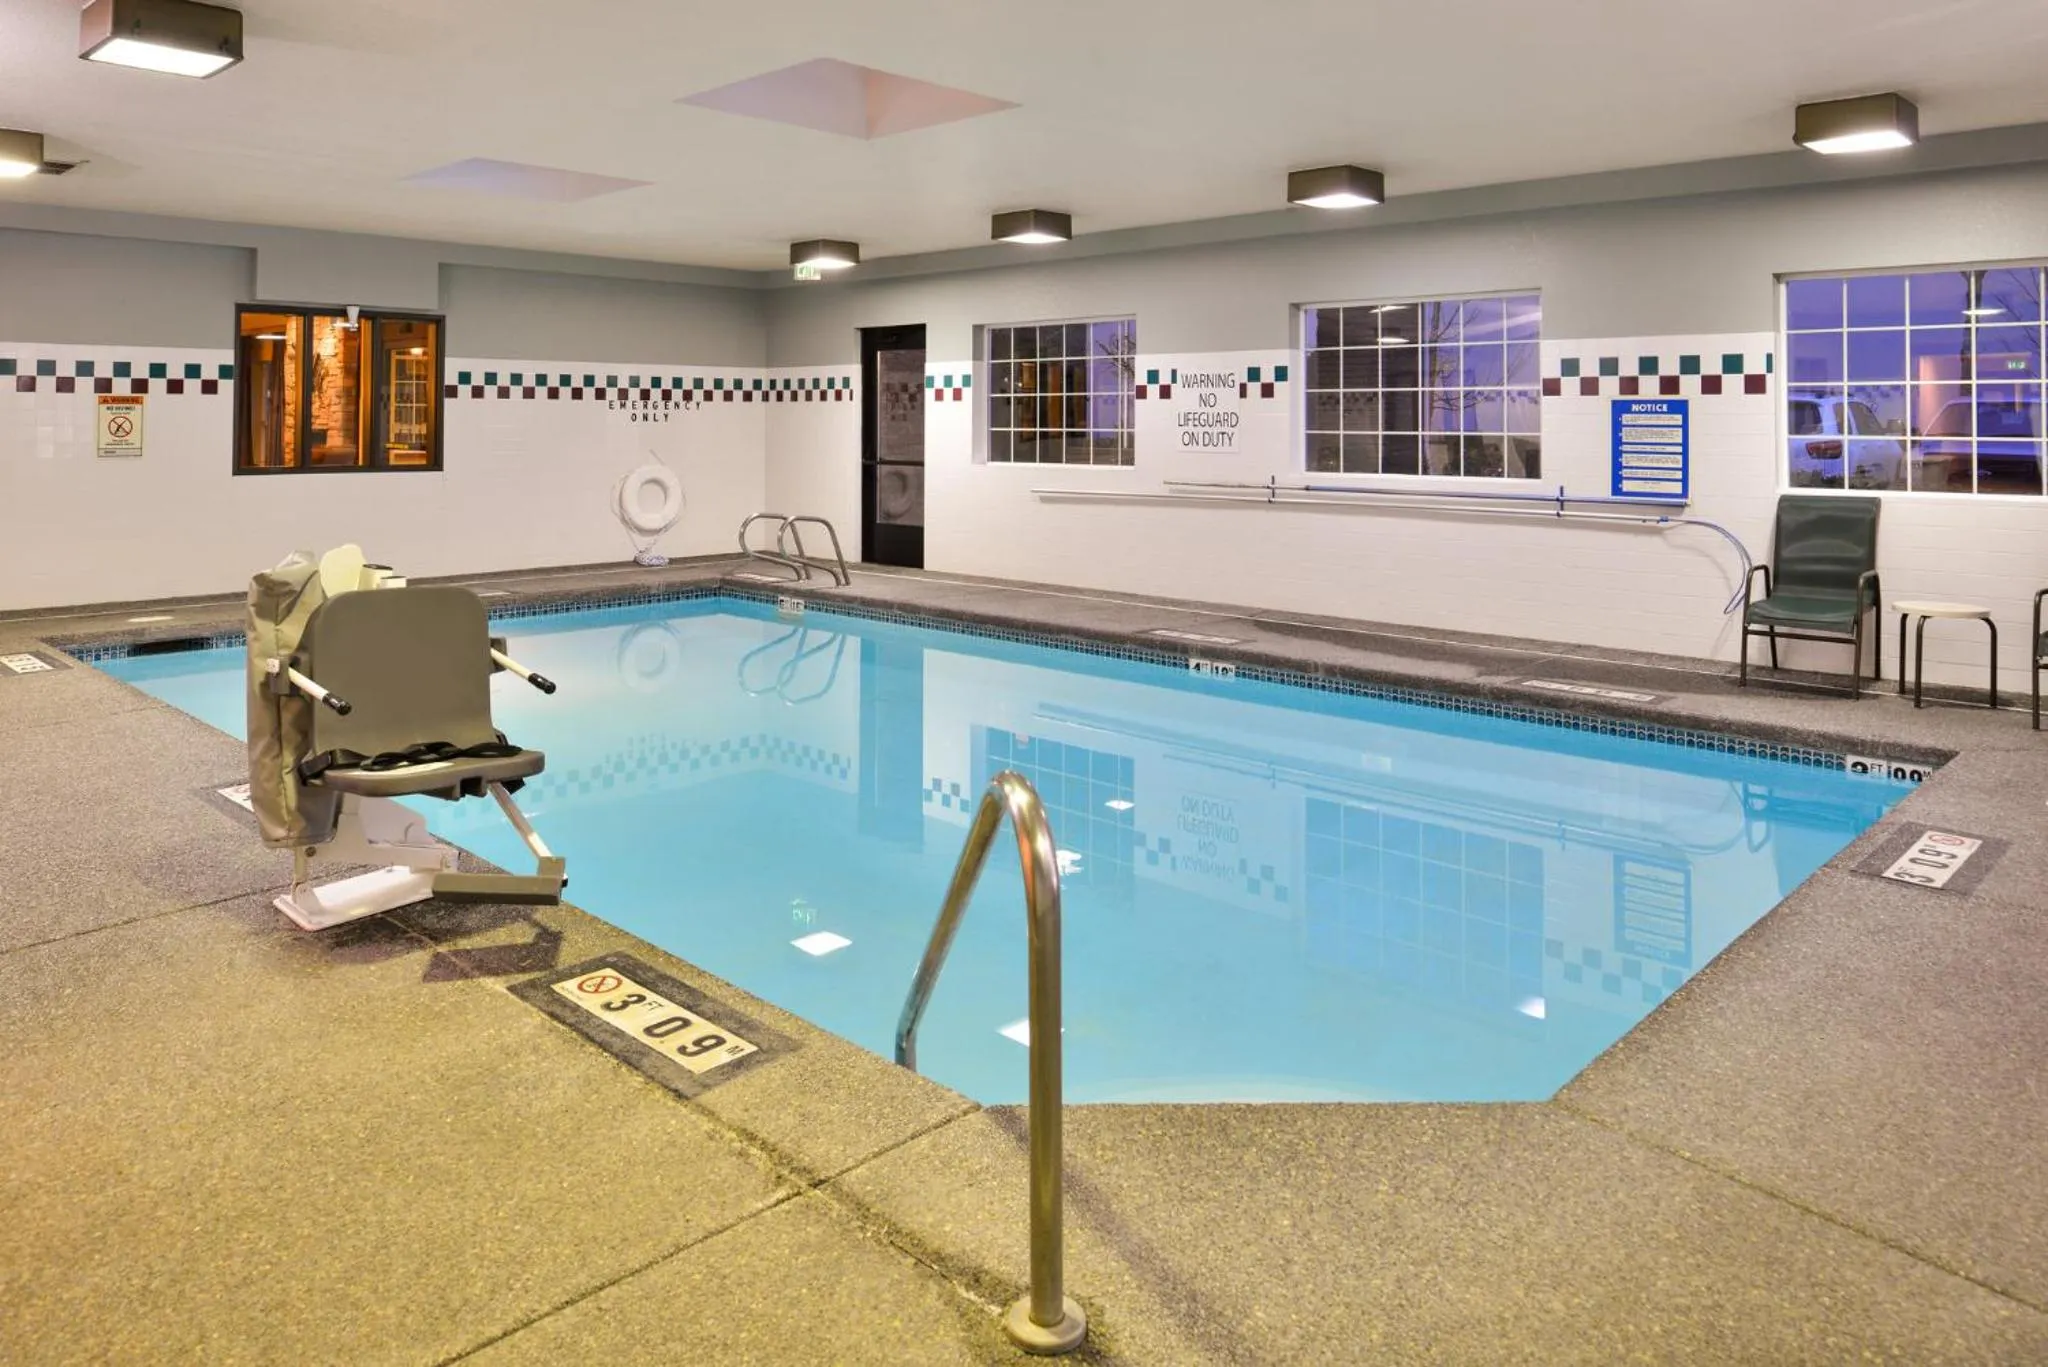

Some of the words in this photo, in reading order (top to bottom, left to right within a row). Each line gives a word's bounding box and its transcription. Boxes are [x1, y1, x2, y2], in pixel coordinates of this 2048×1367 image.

[1181, 373, 1235, 389] WARNING
[608, 400, 701, 411] EMERGENCY
[1199, 393, 1217, 408] NO
[1631, 403, 1668, 412] NOTICE
[631, 413, 669, 422] ONLY
[1178, 412, 1239, 428] LIFEGUARD
[1182, 431, 1199, 446] ON
[1202, 431, 1235, 447] DUTY
